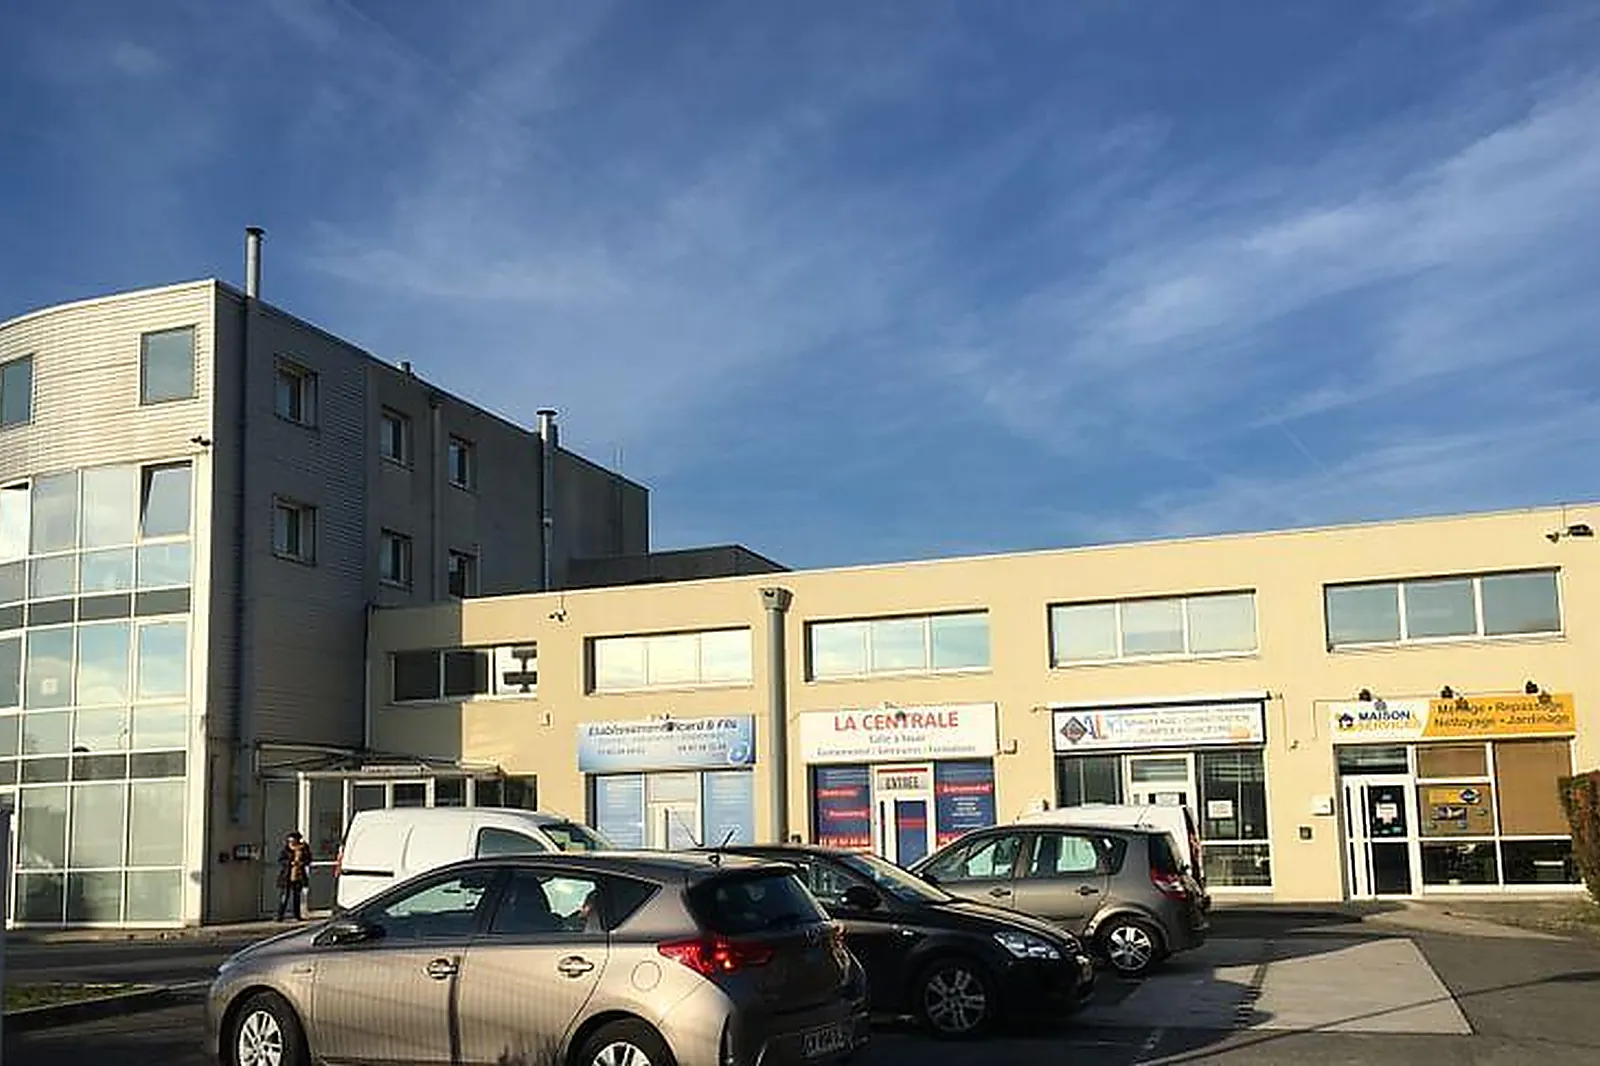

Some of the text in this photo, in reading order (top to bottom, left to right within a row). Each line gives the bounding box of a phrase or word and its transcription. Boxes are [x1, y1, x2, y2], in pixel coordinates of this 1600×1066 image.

[834, 711, 960, 731] LA CENTRALE
[1358, 709, 1411, 721] MAISON
